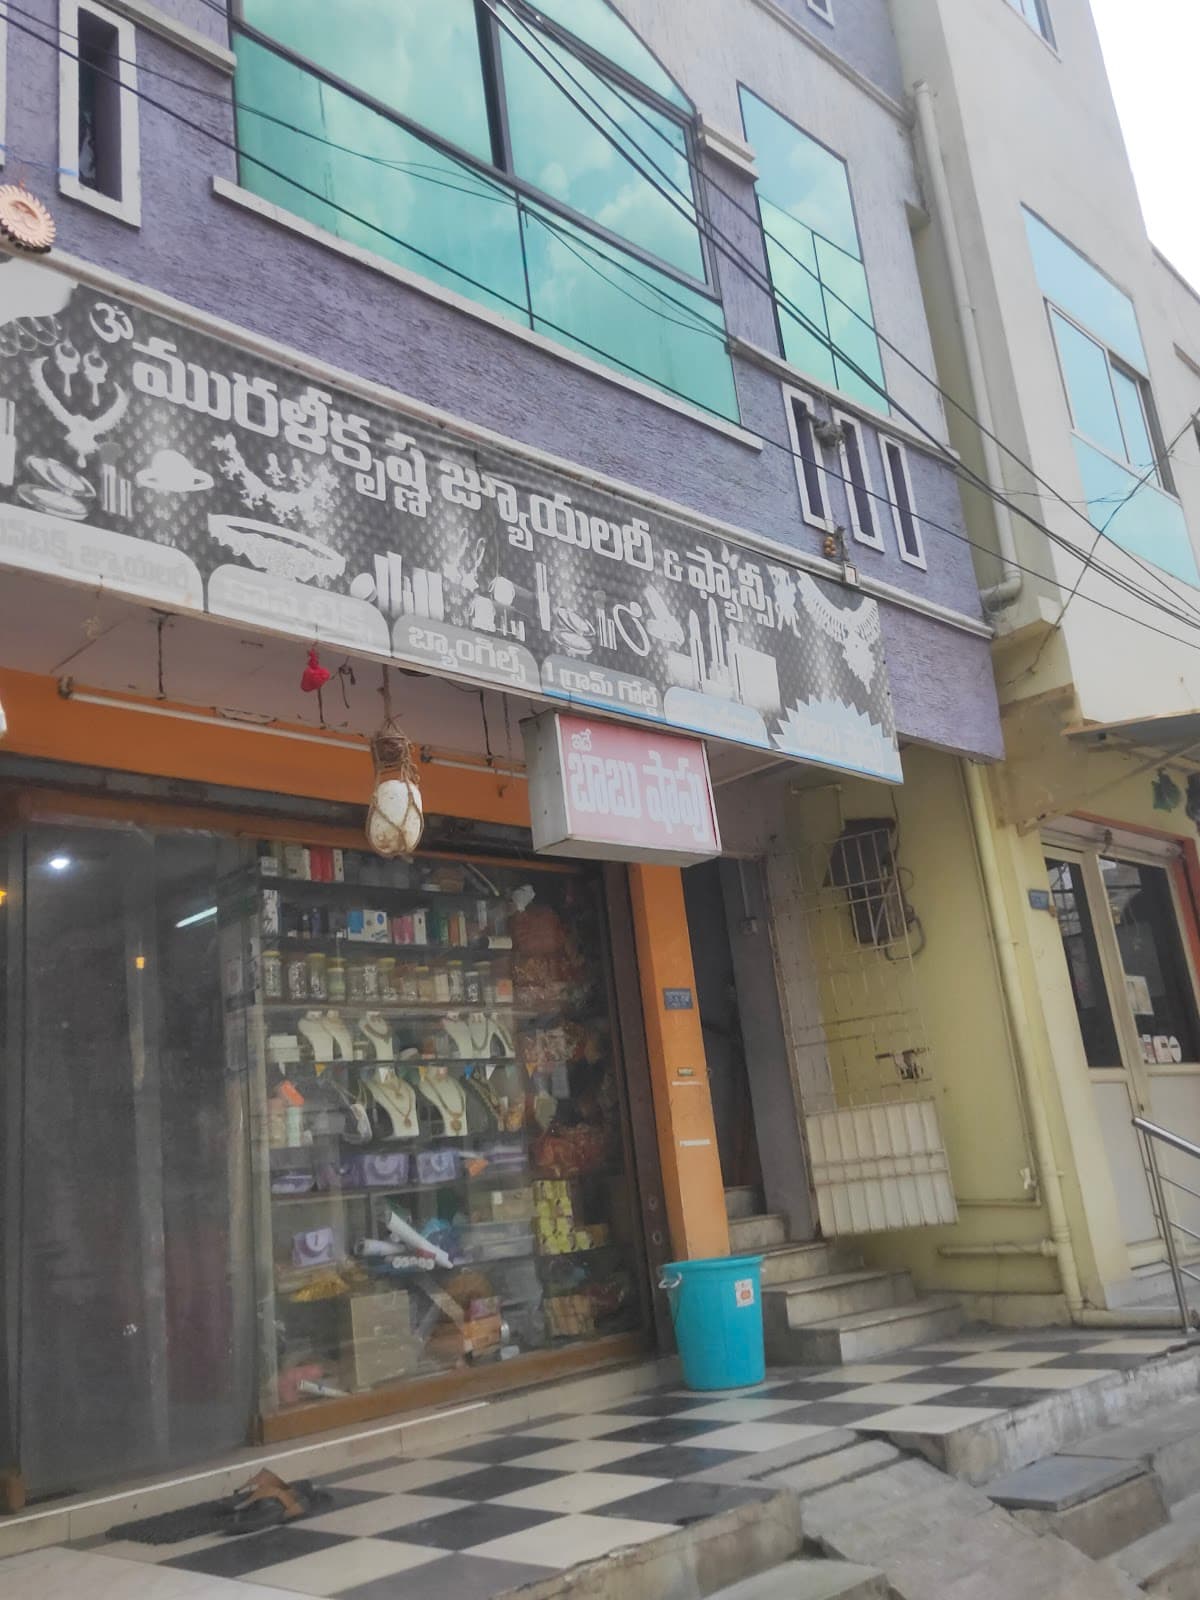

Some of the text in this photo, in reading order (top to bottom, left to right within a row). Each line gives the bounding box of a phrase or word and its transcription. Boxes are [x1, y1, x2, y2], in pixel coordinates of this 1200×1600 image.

[131, 336, 775, 629] మురళీకృష్ణ జ్యూయలరీ & ఫ్యాన్సీ
[545, 661, 554, 683] 1
[567, 752, 642, 819] బాబు
